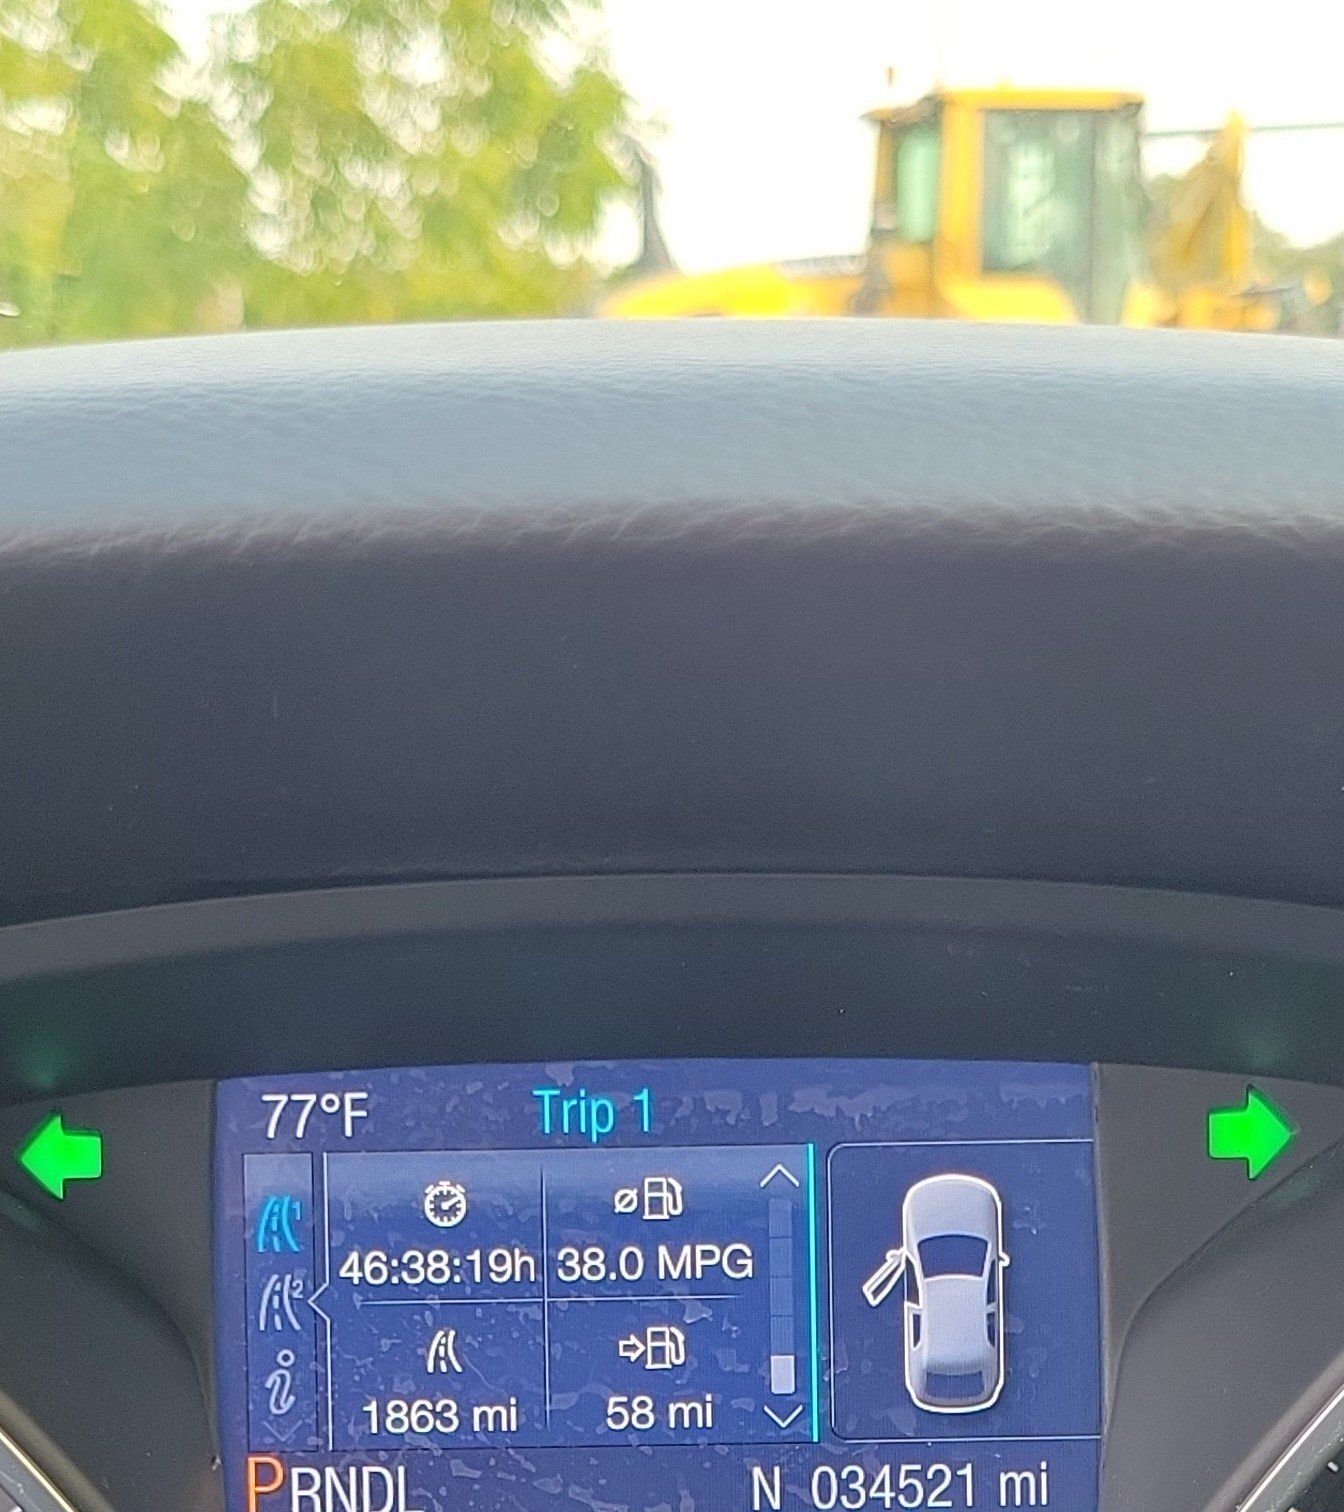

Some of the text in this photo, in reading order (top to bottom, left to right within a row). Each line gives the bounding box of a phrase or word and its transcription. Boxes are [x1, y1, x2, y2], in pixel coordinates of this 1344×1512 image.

[262, 1092, 368, 1138] 77°F
[533, 1087, 651, 1143] Trip 1
[339, 1248, 534, 1284] 46:38:19h
[558, 1244, 752, 1281] 38.0 MPG
[363, 1397, 517, 1434] 1863 mi
[606, 1393, 712, 1429] 58 mi
[753, 1466, 780, 1510] N
[812, 1461, 1047, 1509] 034521 mi
